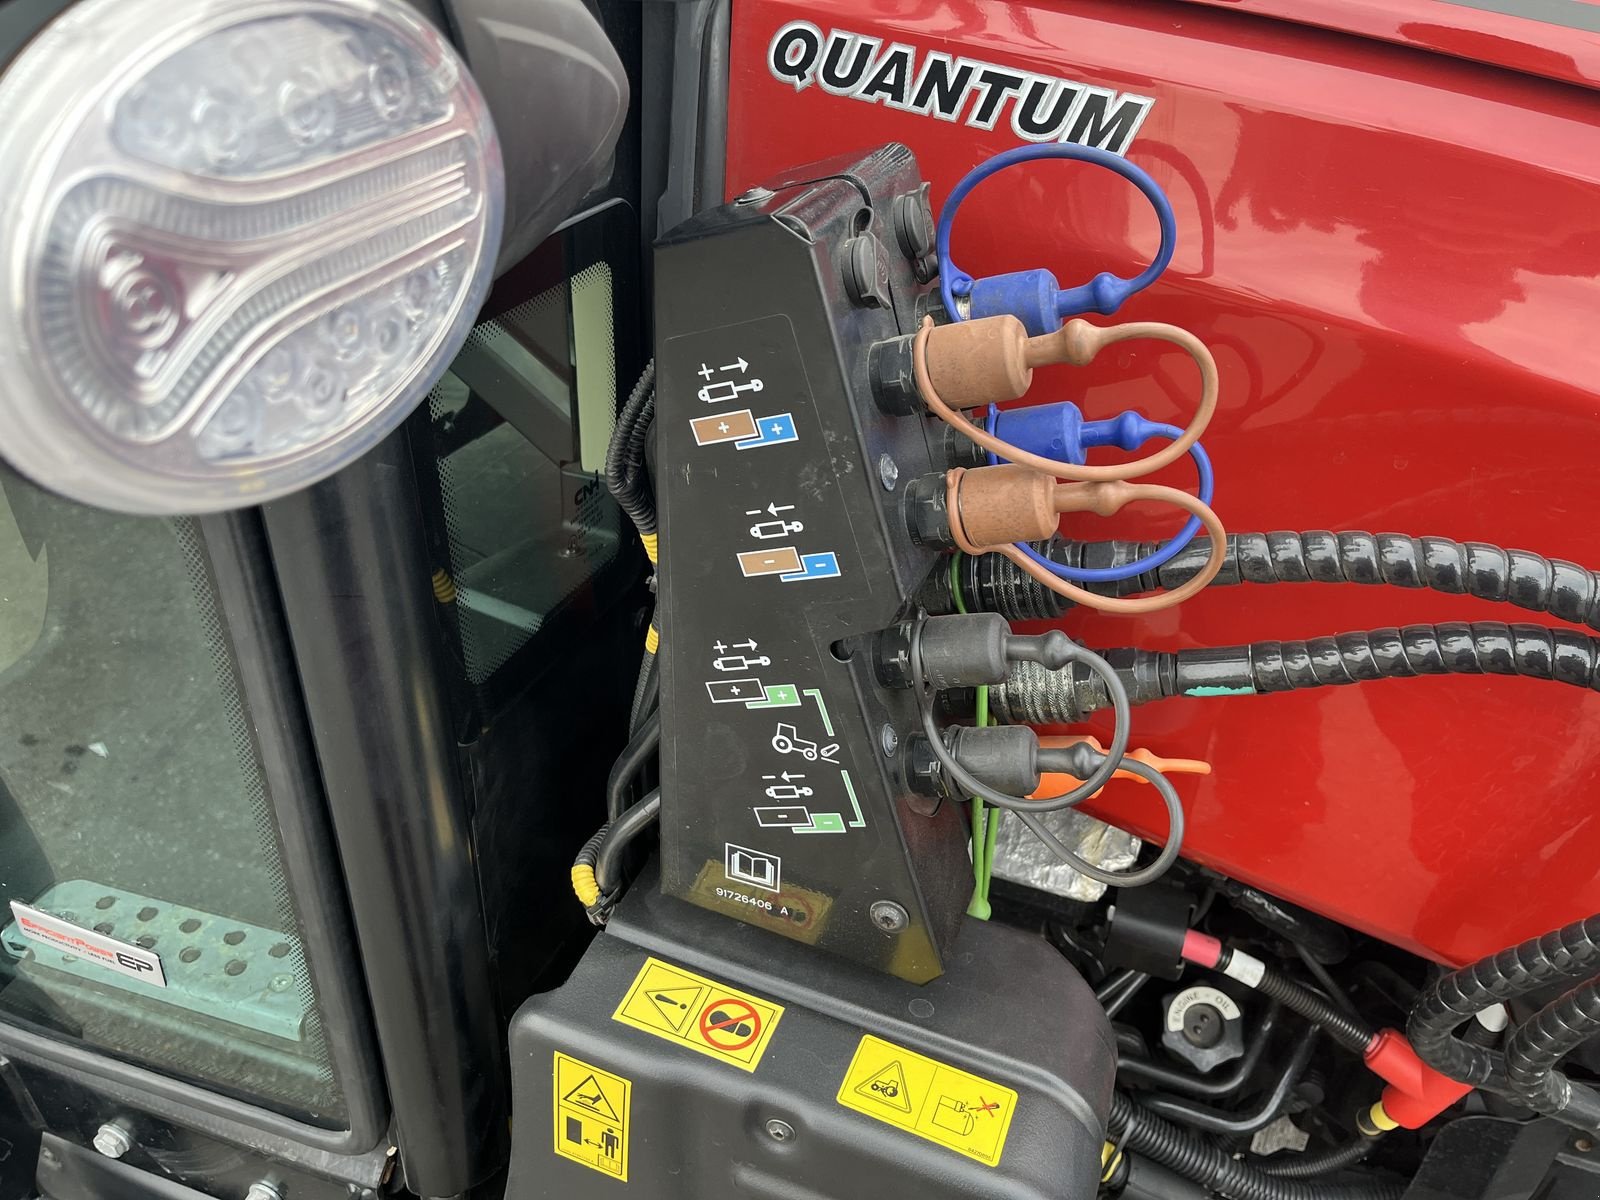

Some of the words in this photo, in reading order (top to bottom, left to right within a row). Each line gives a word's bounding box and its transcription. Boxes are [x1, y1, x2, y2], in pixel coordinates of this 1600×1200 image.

[769, 22, 1151, 155] QUANTUM
[714, 886, 774, 911] 91726406
[780, 905, 789, 916] A
[115, 951, 154, 973] EP
[1171, 990, 1199, 1023] ENGINE
[1214, 994, 1230, 1010] OIL
